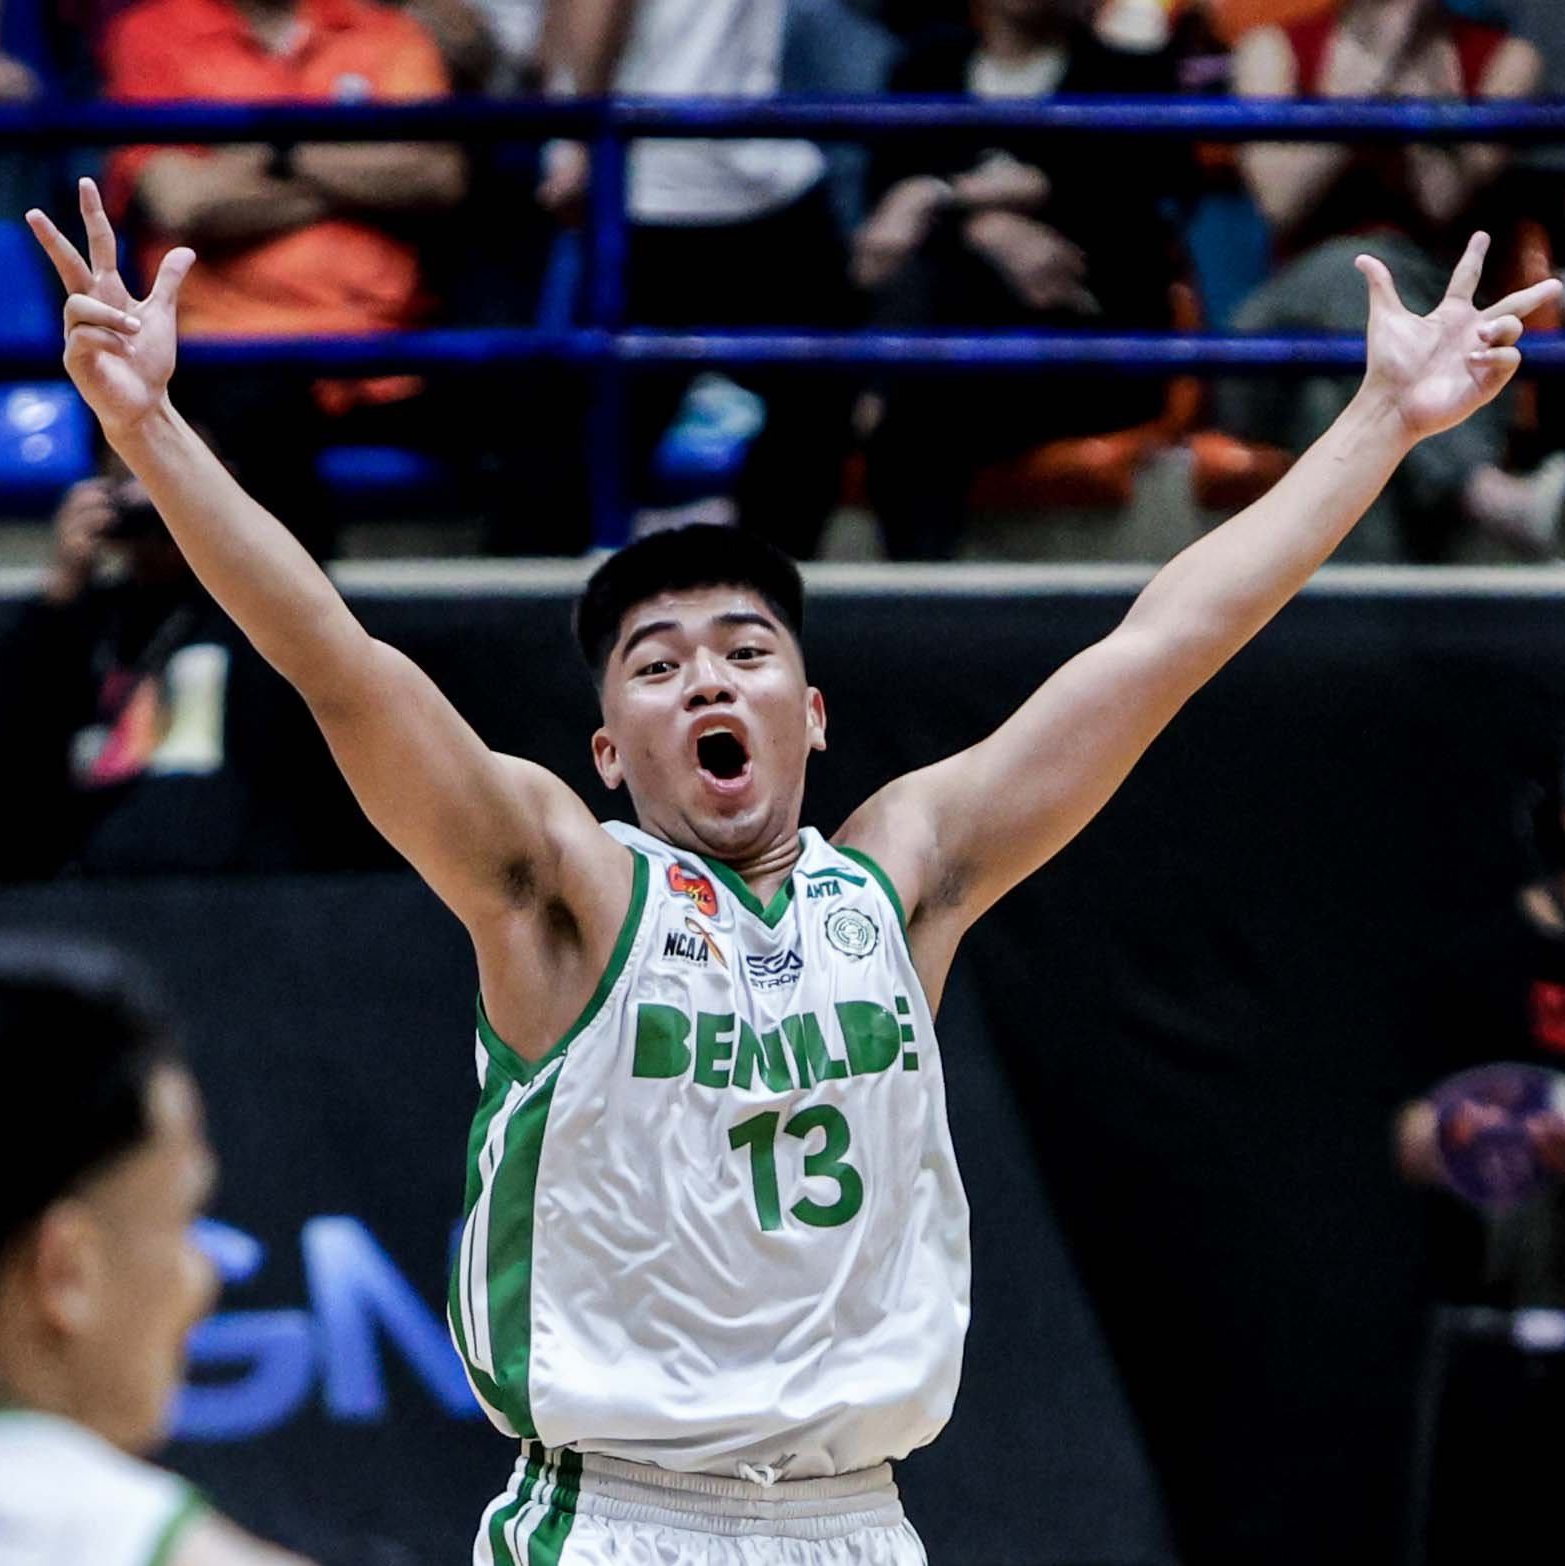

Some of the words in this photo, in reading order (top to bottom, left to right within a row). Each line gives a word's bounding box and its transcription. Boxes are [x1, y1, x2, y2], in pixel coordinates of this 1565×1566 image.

[807, 880, 842, 898] ANTA
[663, 932, 709, 962] NCAA
[728, 1104, 864, 1232] 13
